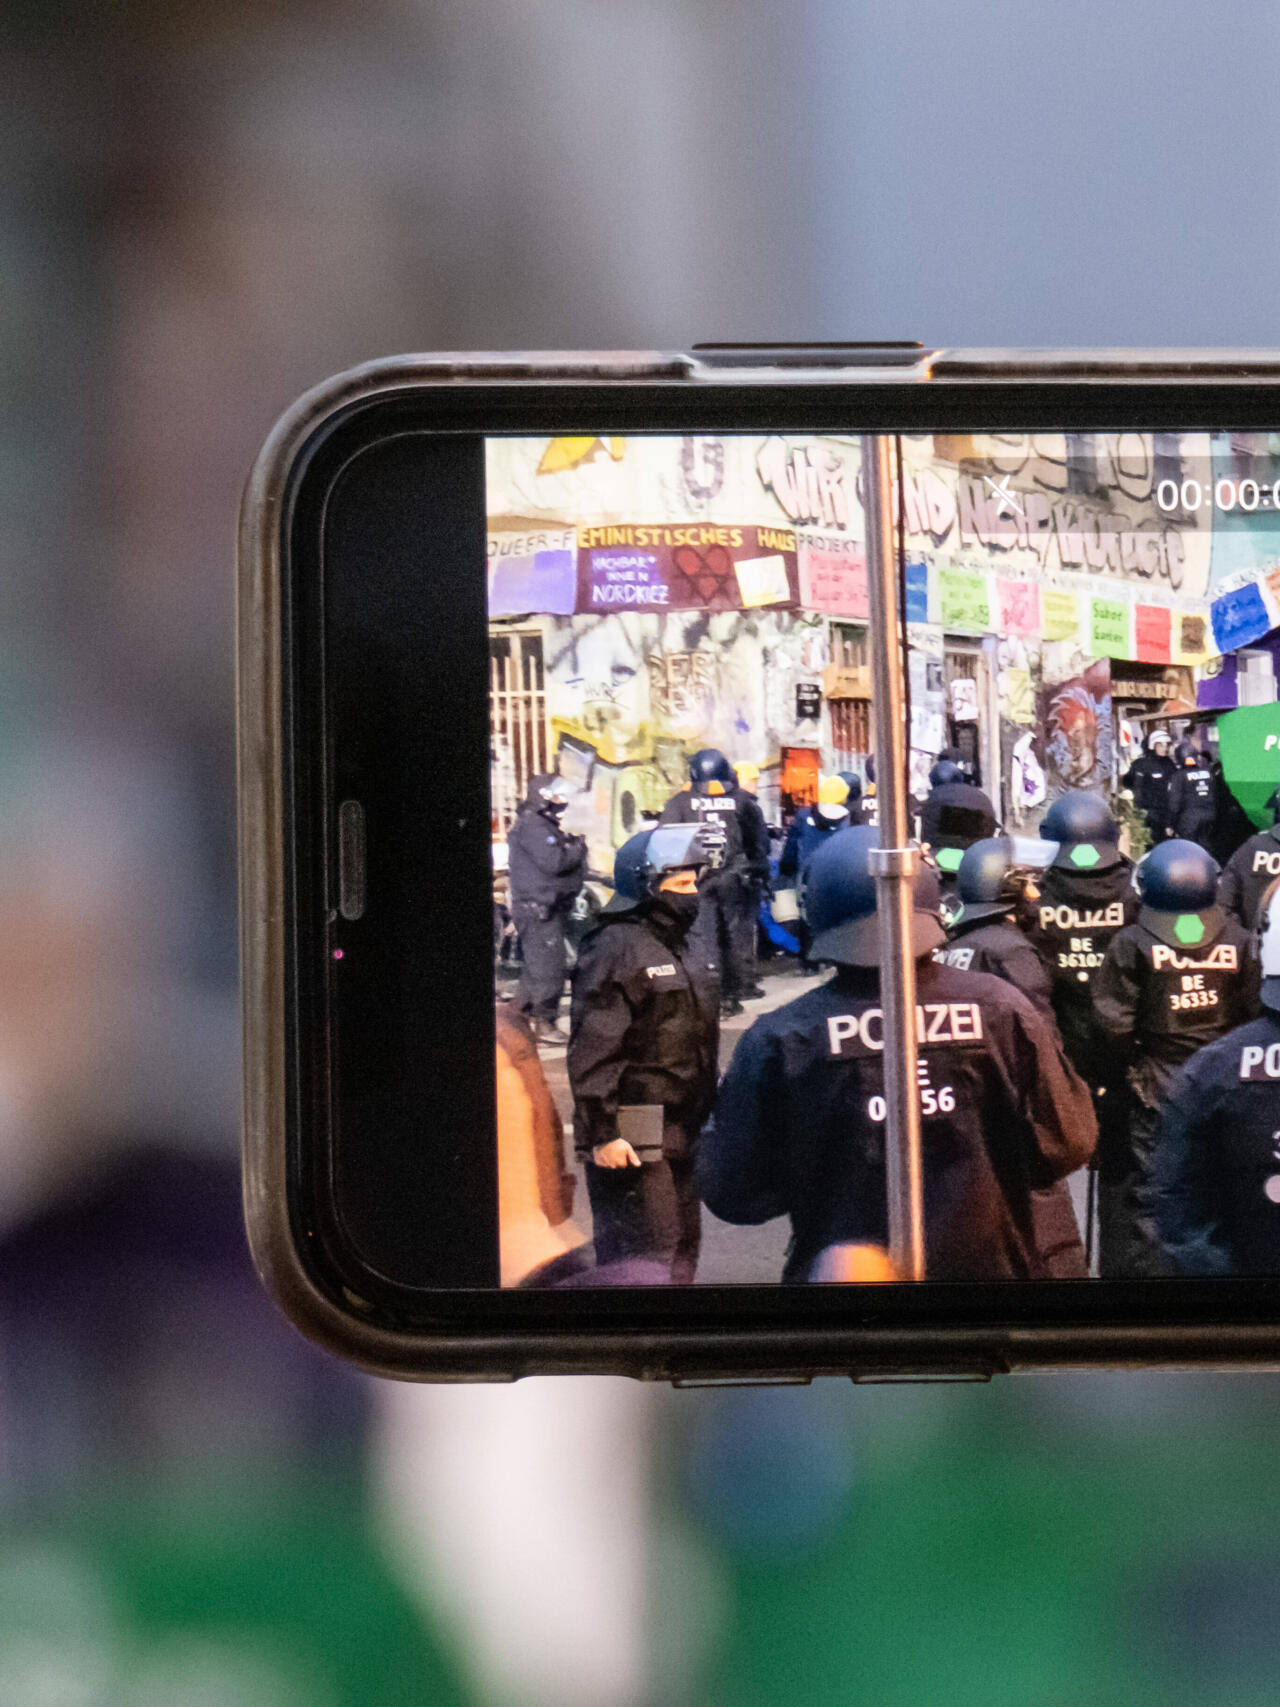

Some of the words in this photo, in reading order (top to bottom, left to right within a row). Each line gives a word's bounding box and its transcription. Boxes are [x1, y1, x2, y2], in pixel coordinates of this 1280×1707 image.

[1070, 938, 1092, 951] BE
[1181, 975, 1205, 992] BE
[1169, 990, 1218, 1010] 36335
[827, 1003, 984, 1055] POIZEI
